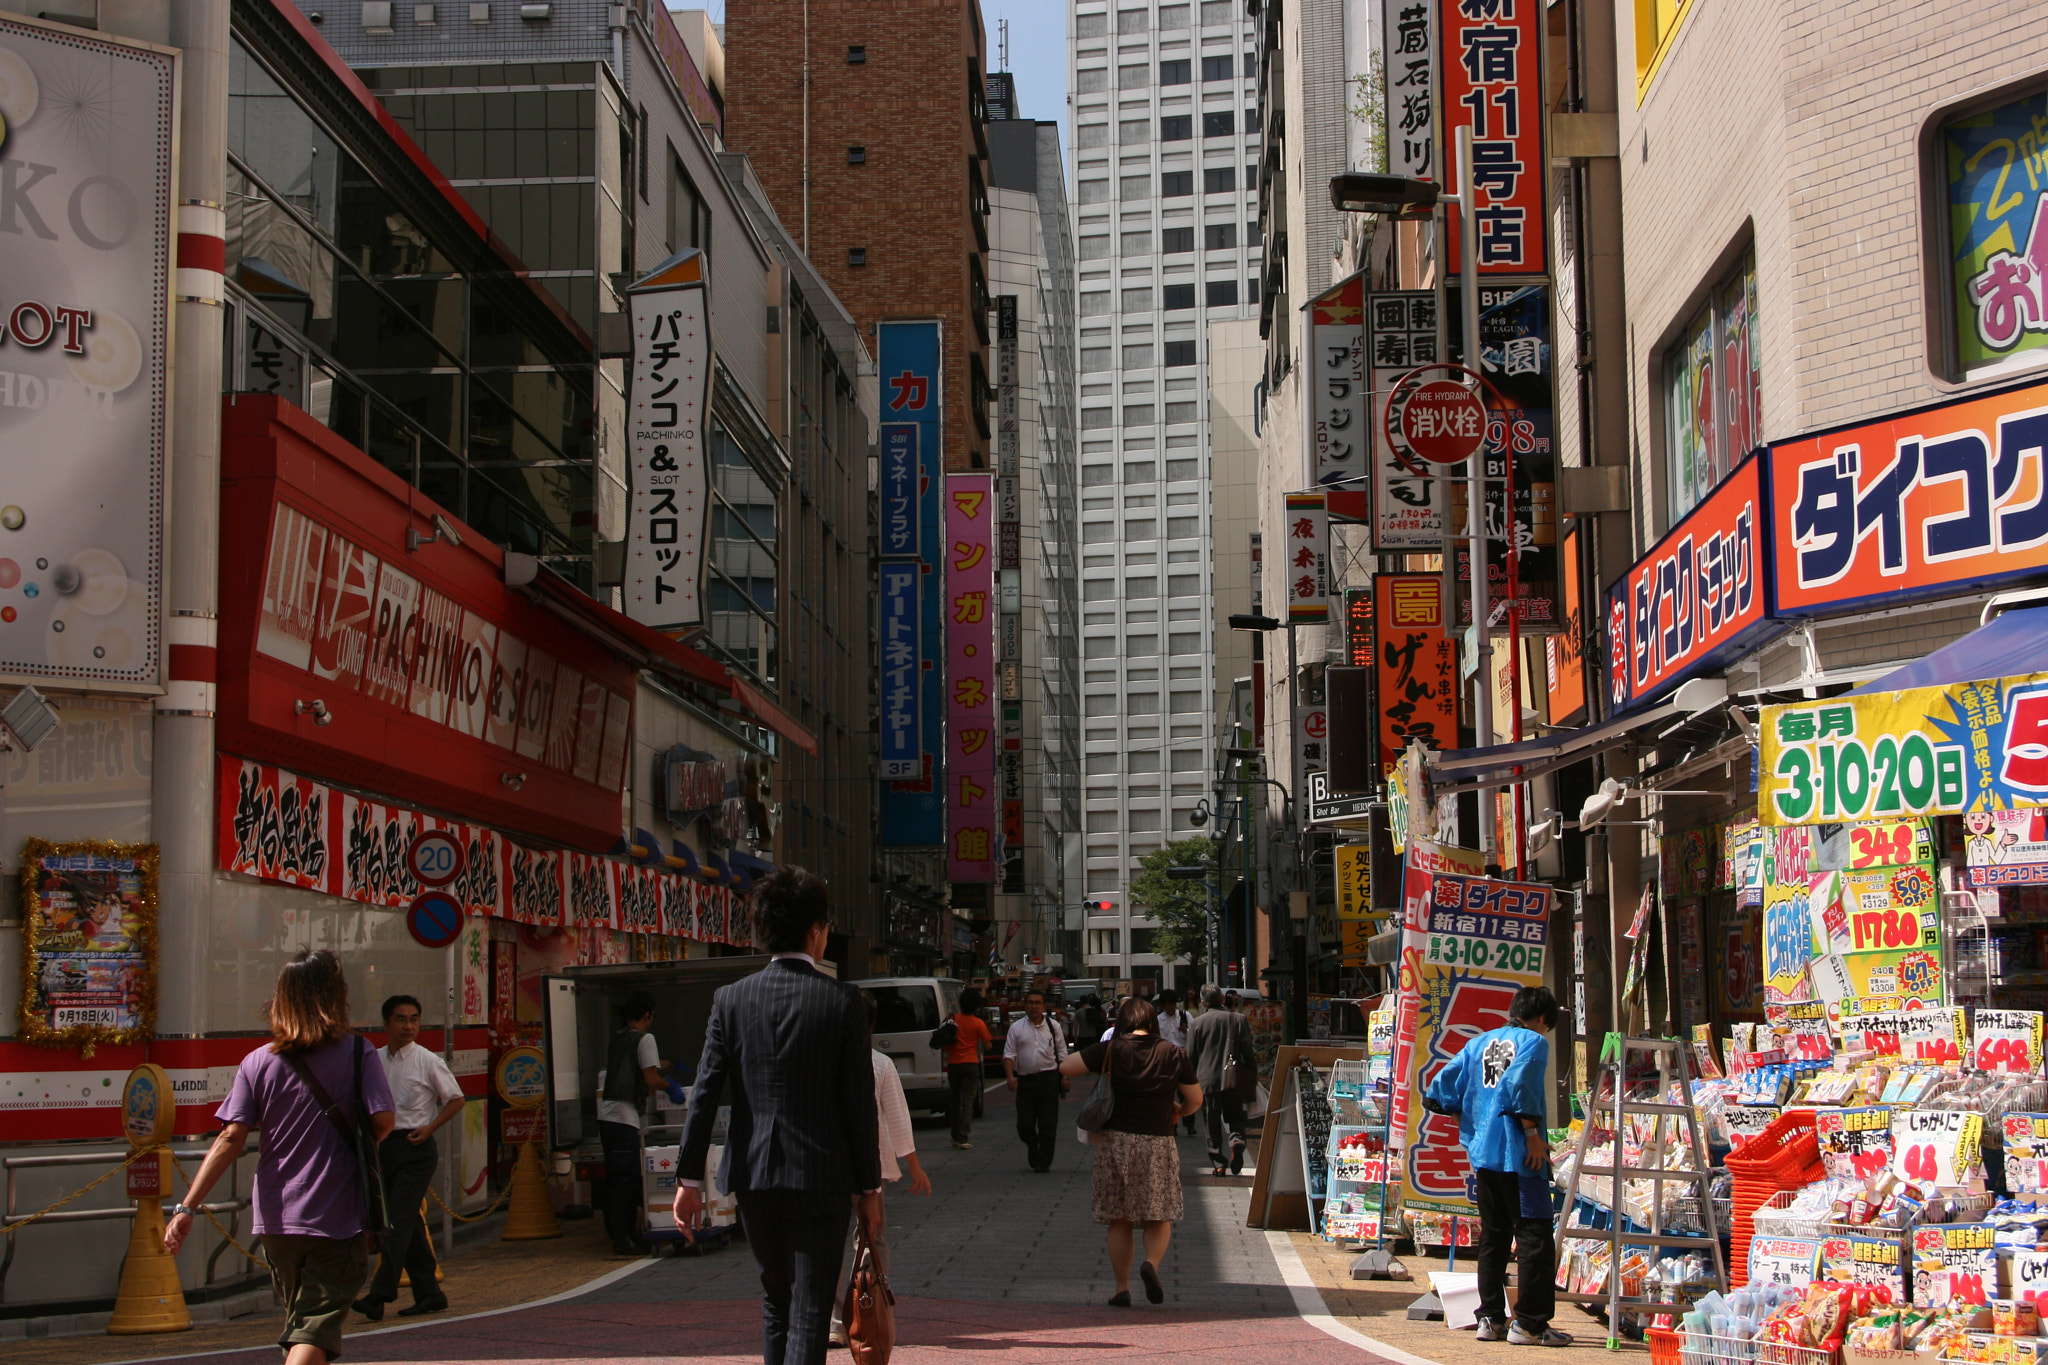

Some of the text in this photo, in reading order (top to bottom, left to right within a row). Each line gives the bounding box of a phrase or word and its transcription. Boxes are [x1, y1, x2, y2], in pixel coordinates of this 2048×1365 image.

[650, 311, 681, 428] パチンコ
[1351, 336, 1364, 381] パチンコ
[1327, 346, 1352, 462] アラジン
[1415, 391, 1470, 401] FIRE HYDRANT
[636, 430, 694, 441] PACHINKO
[1410, 406, 1480, 439] 消火栓
[890, 434, 908, 444] SBI
[1317, 421, 1328, 467] スロット
[650, 444, 679, 472] &
[650, 475, 680, 485] SLOT
[890, 448, 911, 549] マネープラザ
[1291, 517, 1316, 598] 夜来香
[1634, 500, 1755, 687] ダイコクドラッグ
[377, 597, 483, 707] PACHINKO
[886, 573, 913, 750] アートネイチャー
[1609, 595, 1628, 706] 薬
[952, 490, 990, 862] マンガ・ネット館
[1436, 640, 1454, 716] 炭火串焼
[1980, 684, 2003, 727] 全品
[1778, 705, 1855, 743] 毎月
[1961, 689, 1994, 808] 表示価格より
[889, 762, 912, 775] 3F
[1316, 806, 1340, 817] Shot Bar
[419, 847, 452, 872] 20
[1850, 824, 1913, 870] 348
[1918, 845, 1929, 859] 円
[1972, 866, 1986, 886] 薬
[1434, 877, 1463, 908] 薬
[1467, 884, 1546, 916] ダイコク
[1863, 899, 1888, 909] ¥3129
[1903, 892, 1927, 907] OFF
[1433, 911, 1543, 941] 新宿11号店
[1852, 909, 1919, 949] 1780
[1924, 930, 1936, 944] 円
[1430, 936, 1442, 961] 毎月
[1870, 983, 1895, 993] ¥3308
[1909, 977, 1933, 992] OFF
[58, 1009, 115, 1023] 9月18日(火)
